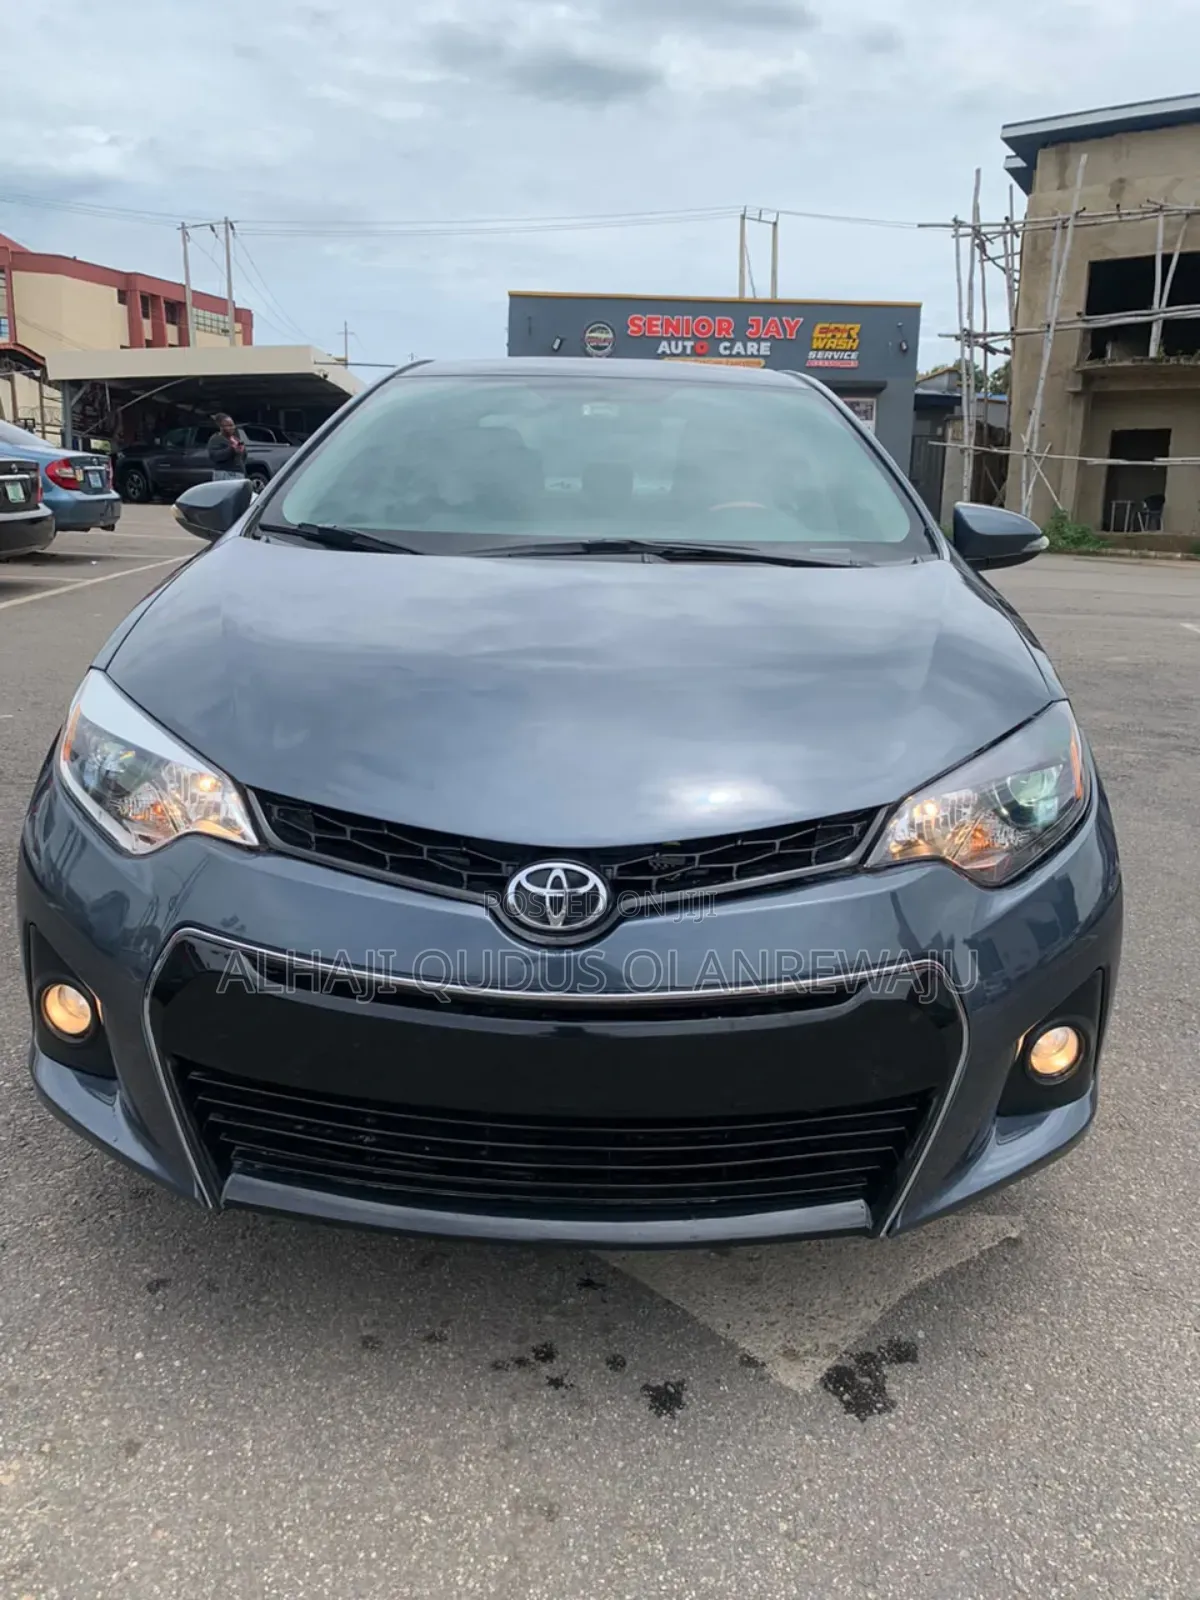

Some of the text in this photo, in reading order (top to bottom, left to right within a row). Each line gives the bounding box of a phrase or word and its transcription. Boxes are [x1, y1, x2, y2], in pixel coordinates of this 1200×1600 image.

[627, 314, 804, 339] SENIOR JAY
[813, 323, 861, 338] CAR
[656, 341, 771, 356] AUTO CARE
[811, 337, 859, 350] WASH
[808, 350, 860, 360] SERVICE
